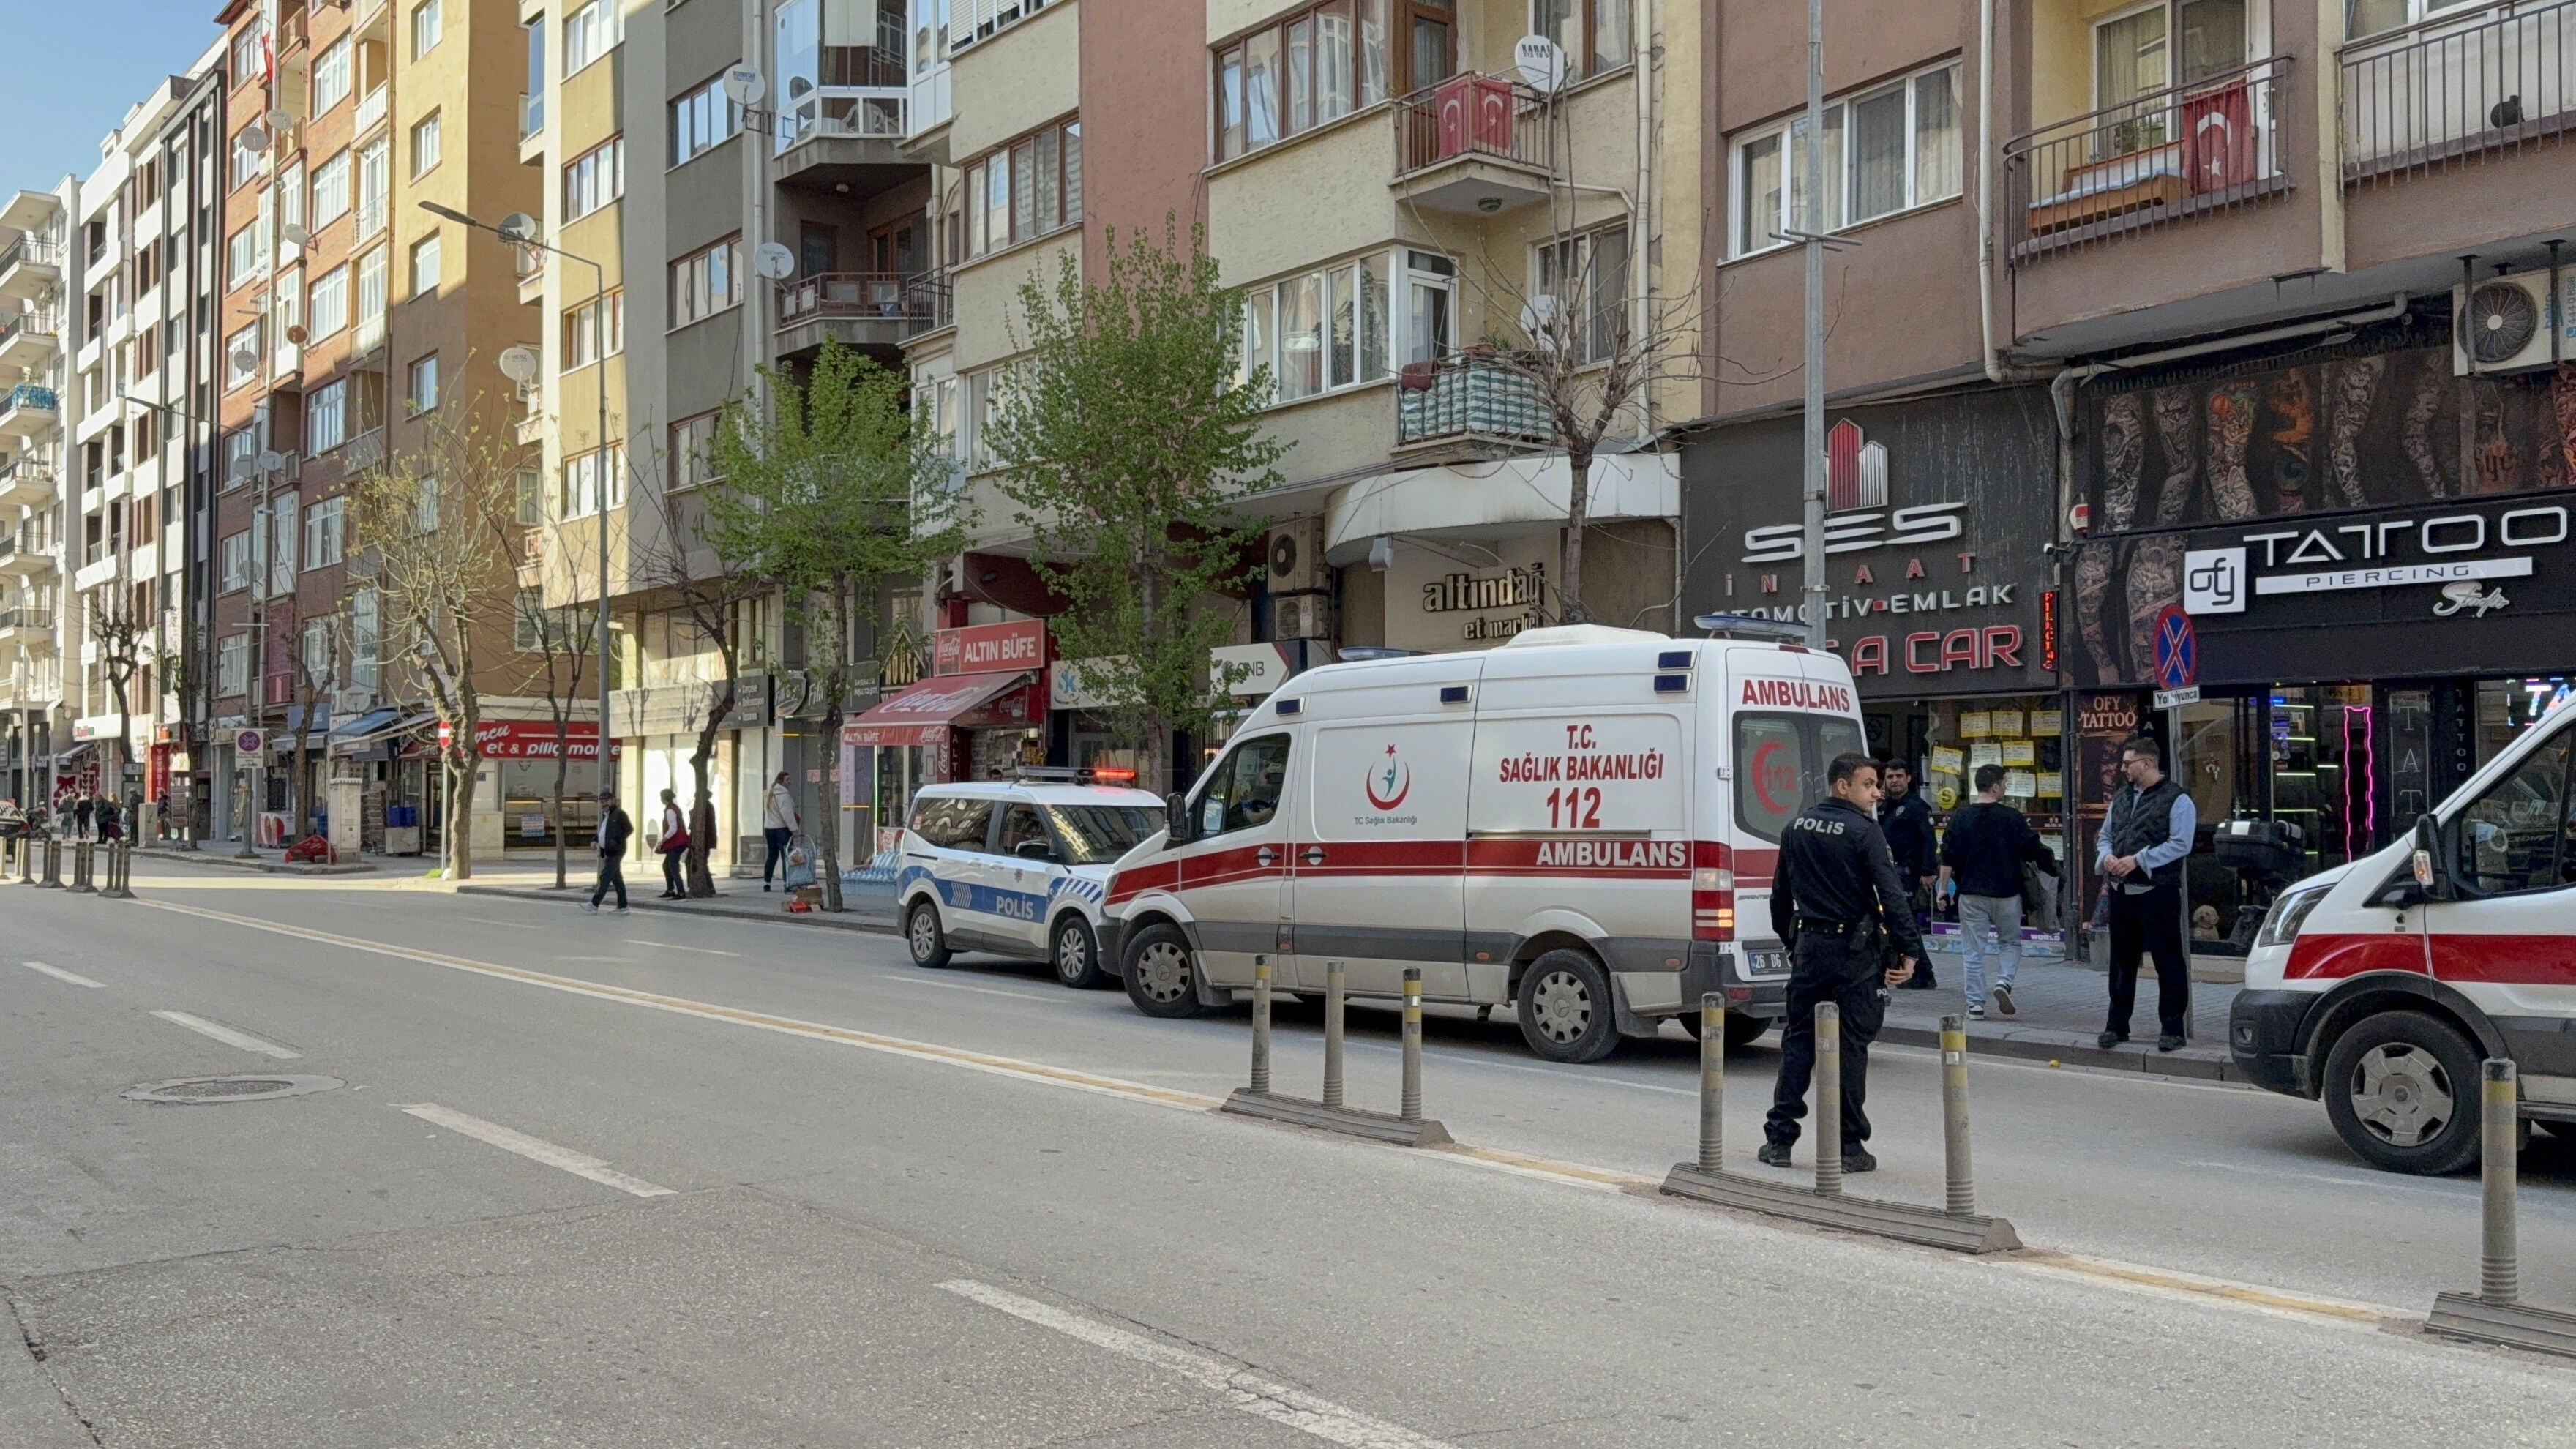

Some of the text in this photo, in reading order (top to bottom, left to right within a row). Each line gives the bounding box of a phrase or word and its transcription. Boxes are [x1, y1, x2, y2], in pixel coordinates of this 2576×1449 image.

[1741, 502, 1967, 563] SES
[1724, 552, 1975, 596] İNAAT
[2306, 564, 2471, 588] PIERCING
[1891, 583, 2018, 613] EMLAK
[1464, 617, 1486, 640] et
[964, 632, 1036, 663] ALTIN BÜFE
[1852, 635, 1889, 677] A
[1906, 624, 2024, 673] CAR
[1742, 679, 1850, 712] AMBULANS
[2093, 696, 2122, 711] OFY
[2156, 693, 2169, 705] Yol
[2081, 710, 2138, 729] TATTOO
[487, 741, 505, 754] et
[1566, 724, 1597, 750] T.C.
[1500, 747, 1664, 782] SAĞLIK BAKANLIĞI
[1546, 787, 1602, 829] 112
[1535, 842, 1687, 866] AMBULANS
[996, 894, 1033, 920] POLİS
[1754, 954, 1765, 969] 26
